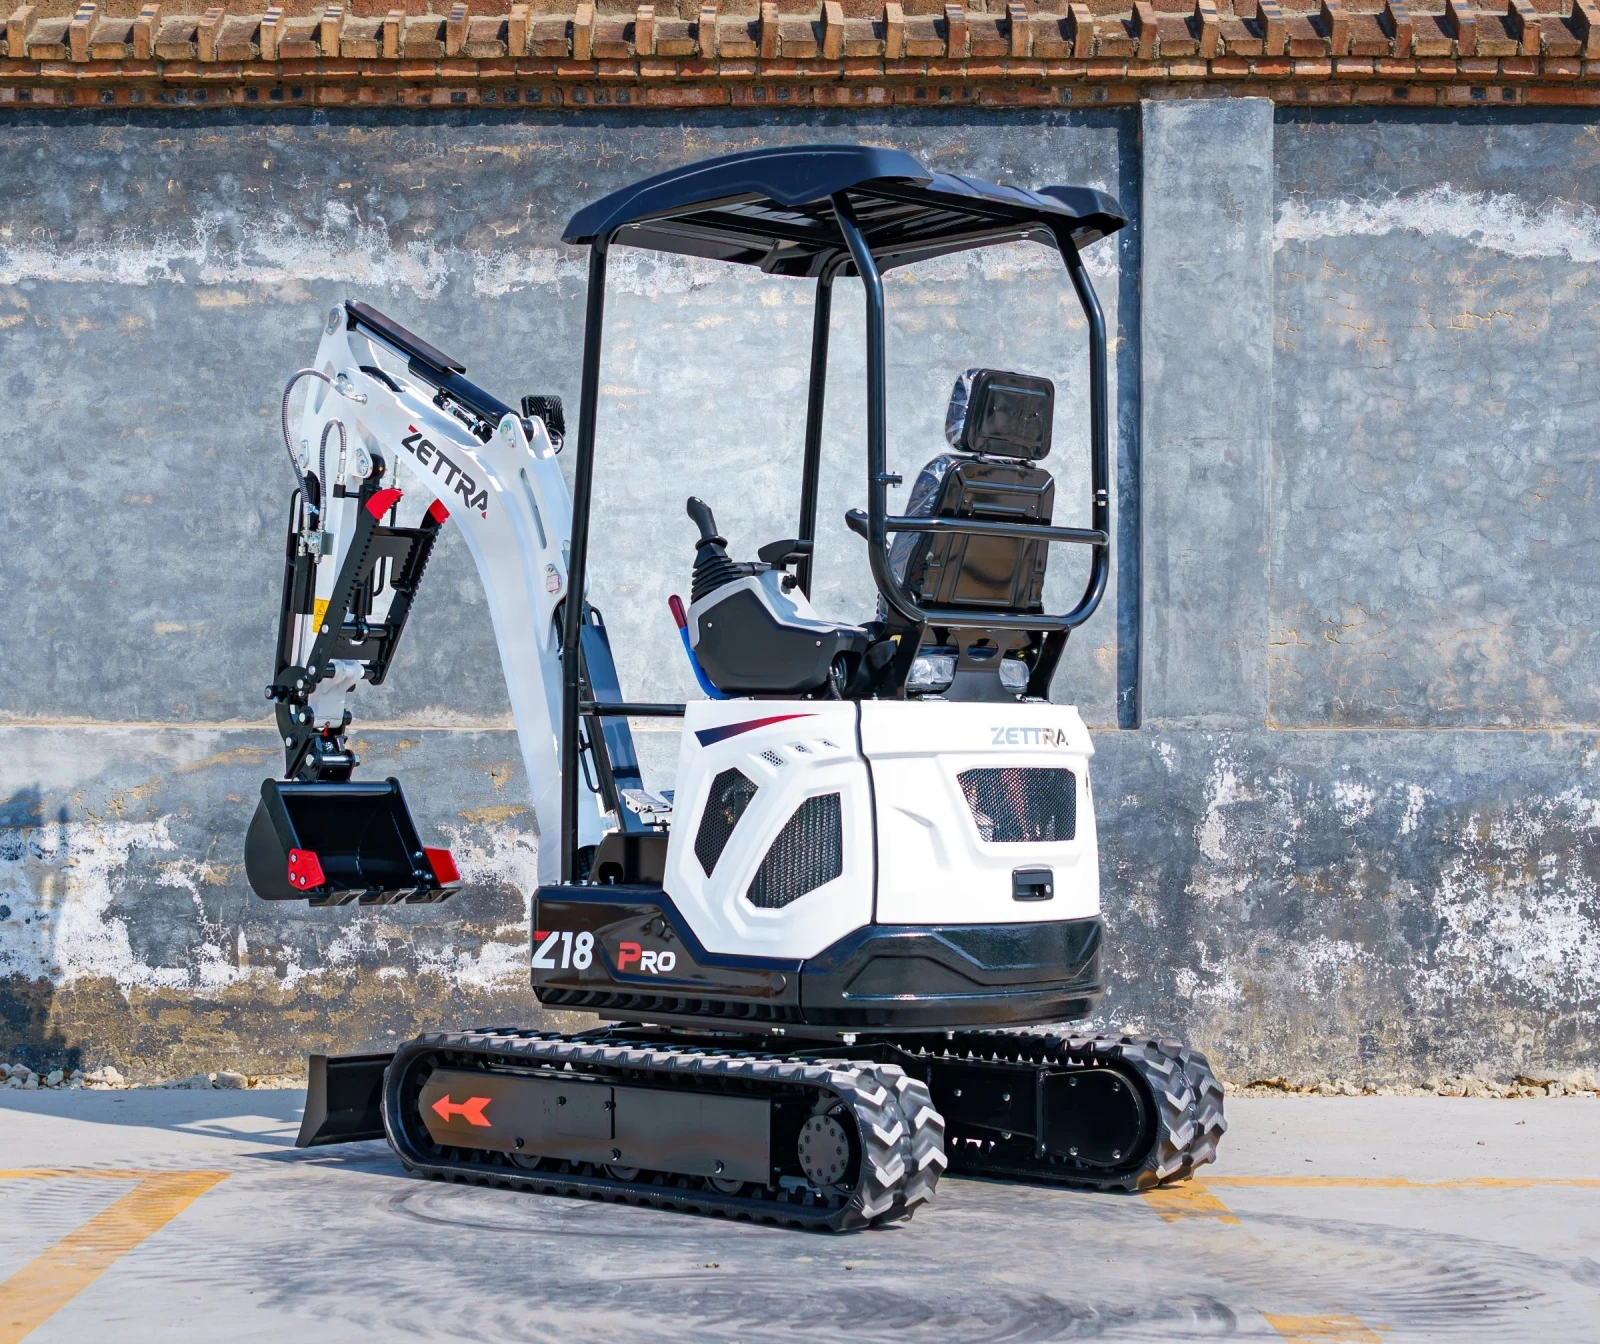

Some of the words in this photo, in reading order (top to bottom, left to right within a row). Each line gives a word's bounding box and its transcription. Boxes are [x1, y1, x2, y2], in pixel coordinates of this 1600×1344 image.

[401, 424, 489, 520] ZETTRA
[990, 727, 1069, 748] ZETTRA
[531, 931, 595, 970] Z18
